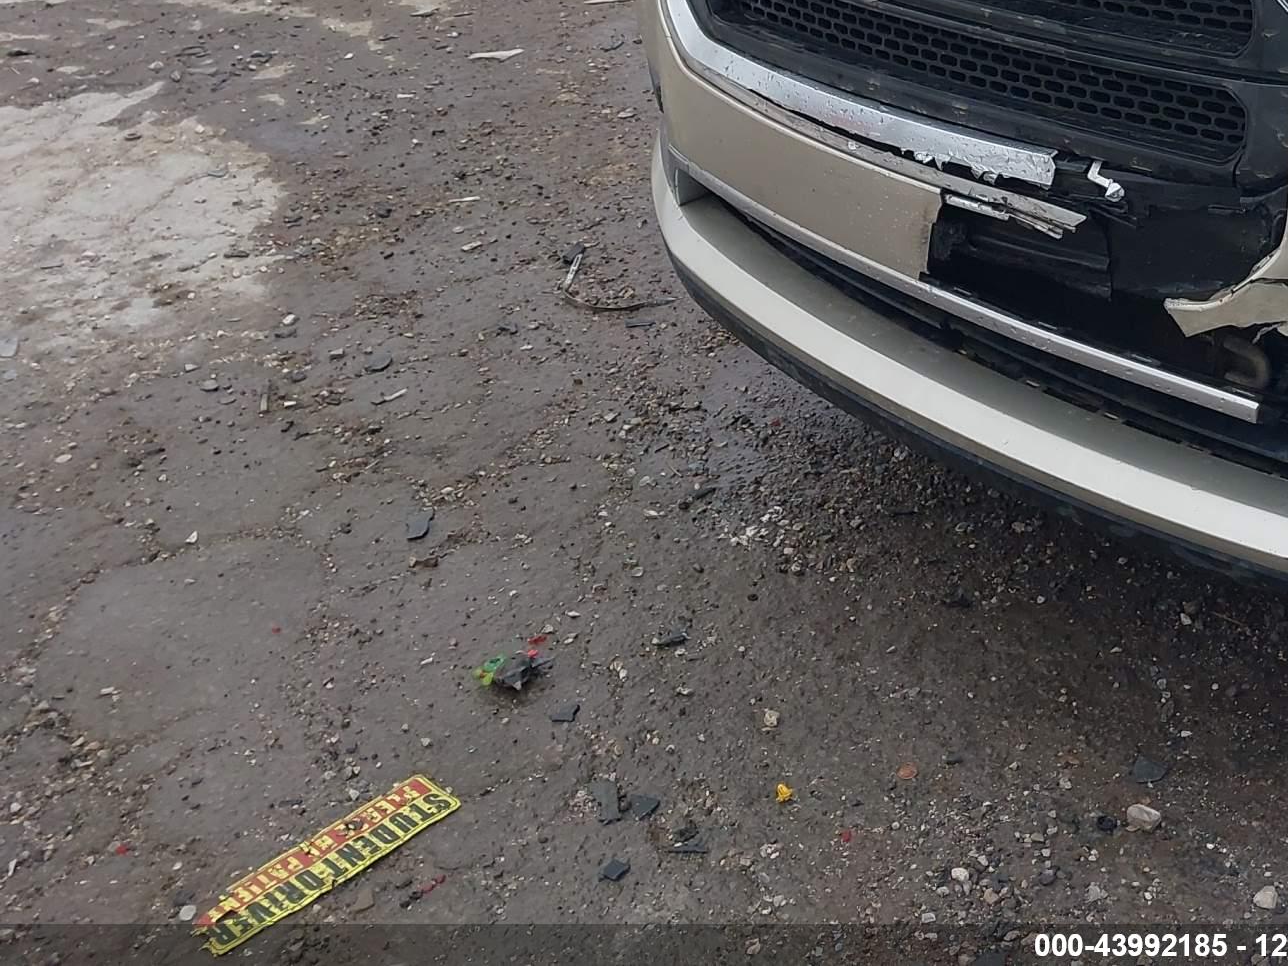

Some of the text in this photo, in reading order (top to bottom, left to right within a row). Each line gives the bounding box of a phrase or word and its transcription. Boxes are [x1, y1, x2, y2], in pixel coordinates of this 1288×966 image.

[339, 785, 421, 839] PLEAE
[207, 793, 452, 945] STUDENT DRIVER
